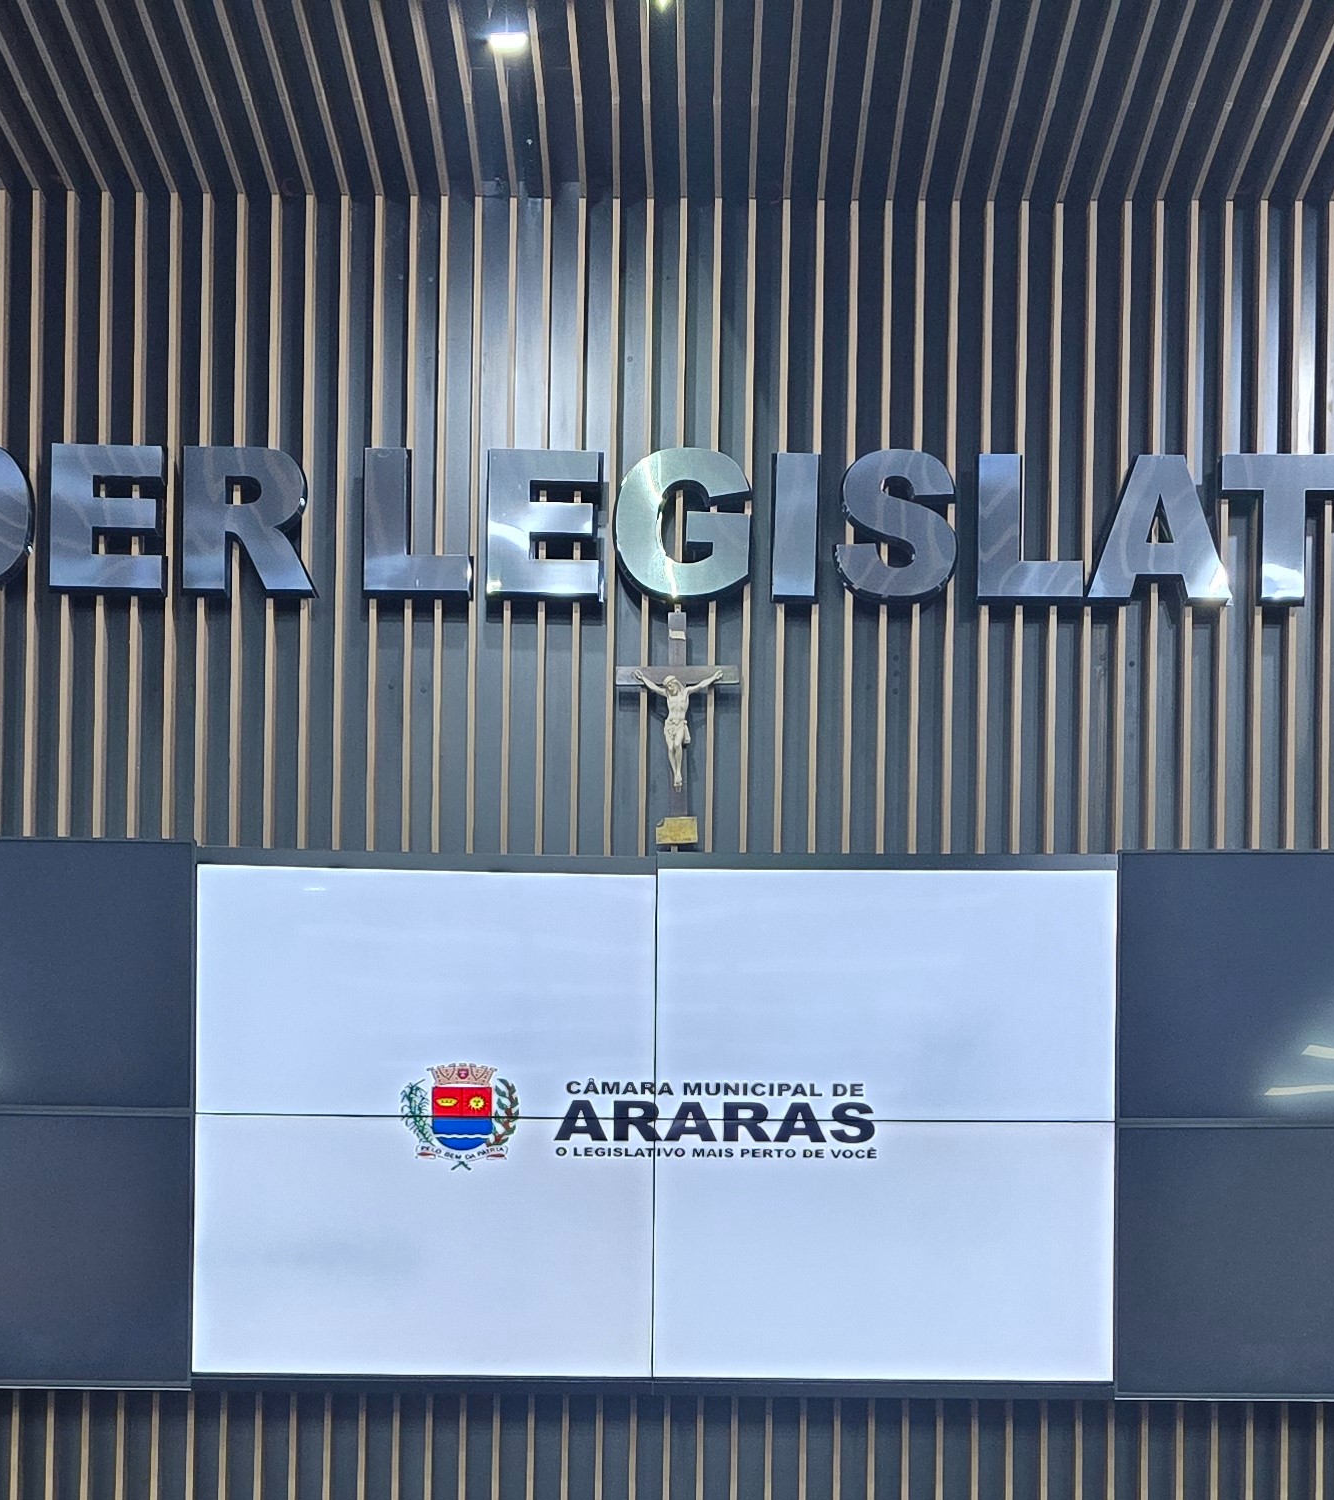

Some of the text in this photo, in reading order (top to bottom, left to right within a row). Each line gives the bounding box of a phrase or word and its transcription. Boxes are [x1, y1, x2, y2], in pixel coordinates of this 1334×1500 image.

[566, 1078, 864, 1097] CÂMARA MUNICIPAL DE
[553, 1099, 876, 1144] ARARAS
[555, 1146, 878, 1159] O LEGISLATIVO MAIS PERTO DE VOCÊ
